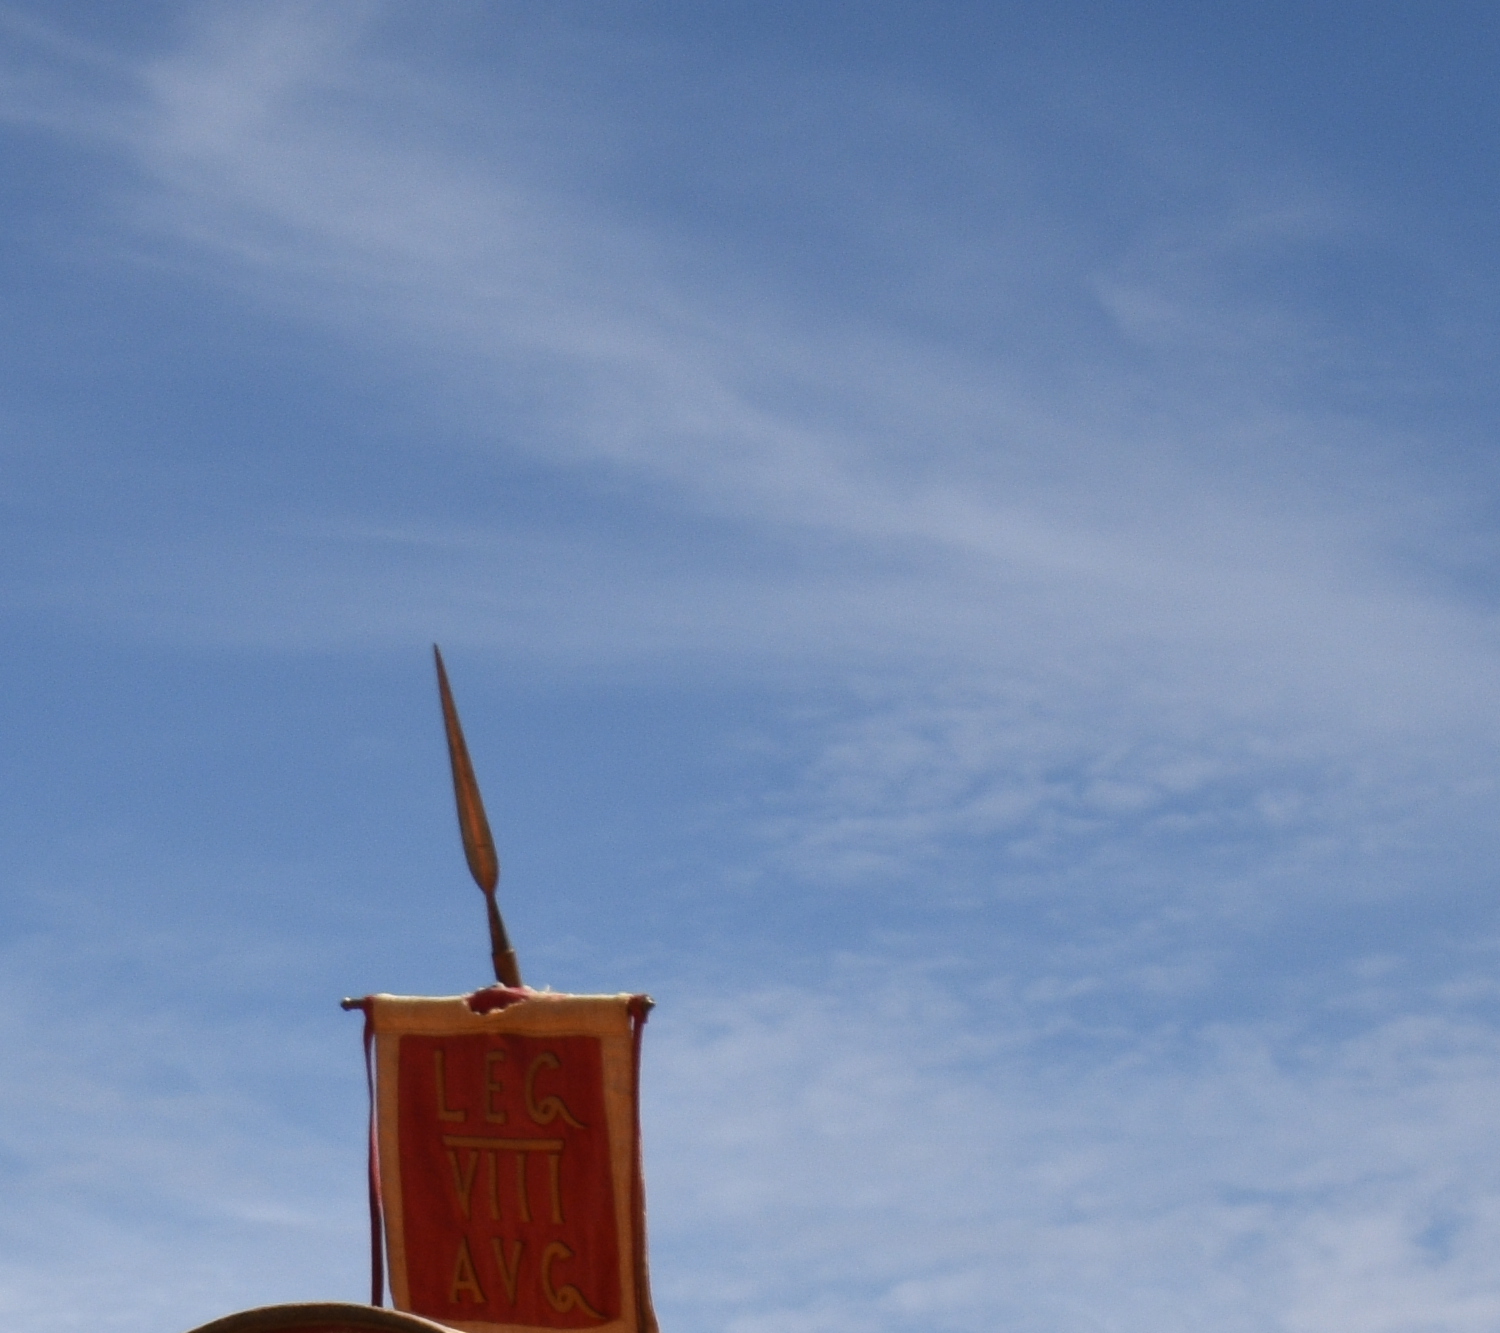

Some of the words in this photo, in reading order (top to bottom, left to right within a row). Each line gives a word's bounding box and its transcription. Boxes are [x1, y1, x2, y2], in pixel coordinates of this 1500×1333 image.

[434, 1050, 588, 1129] LEG
[442, 1135, 564, 1225] VIII
[449, 1236, 608, 1320] AVG
